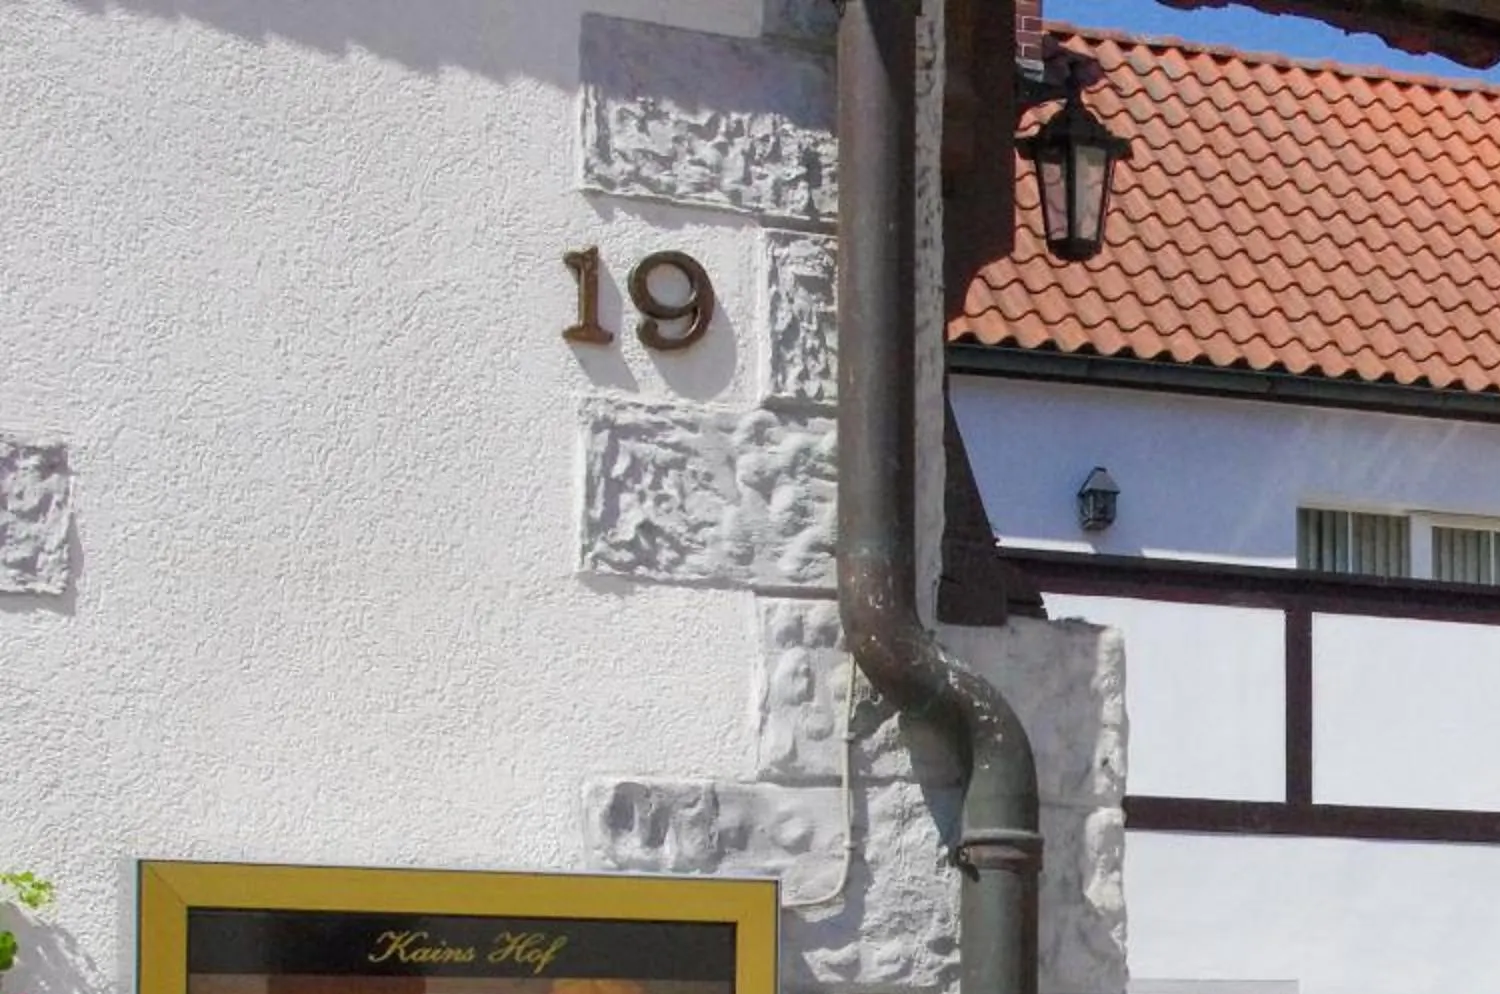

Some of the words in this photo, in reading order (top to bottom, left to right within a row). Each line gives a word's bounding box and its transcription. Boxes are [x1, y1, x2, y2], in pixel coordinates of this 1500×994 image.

[562, 245, 716, 352] 19
[368, 930, 475, 963] Kains
[488, 931, 569, 975] Hof
